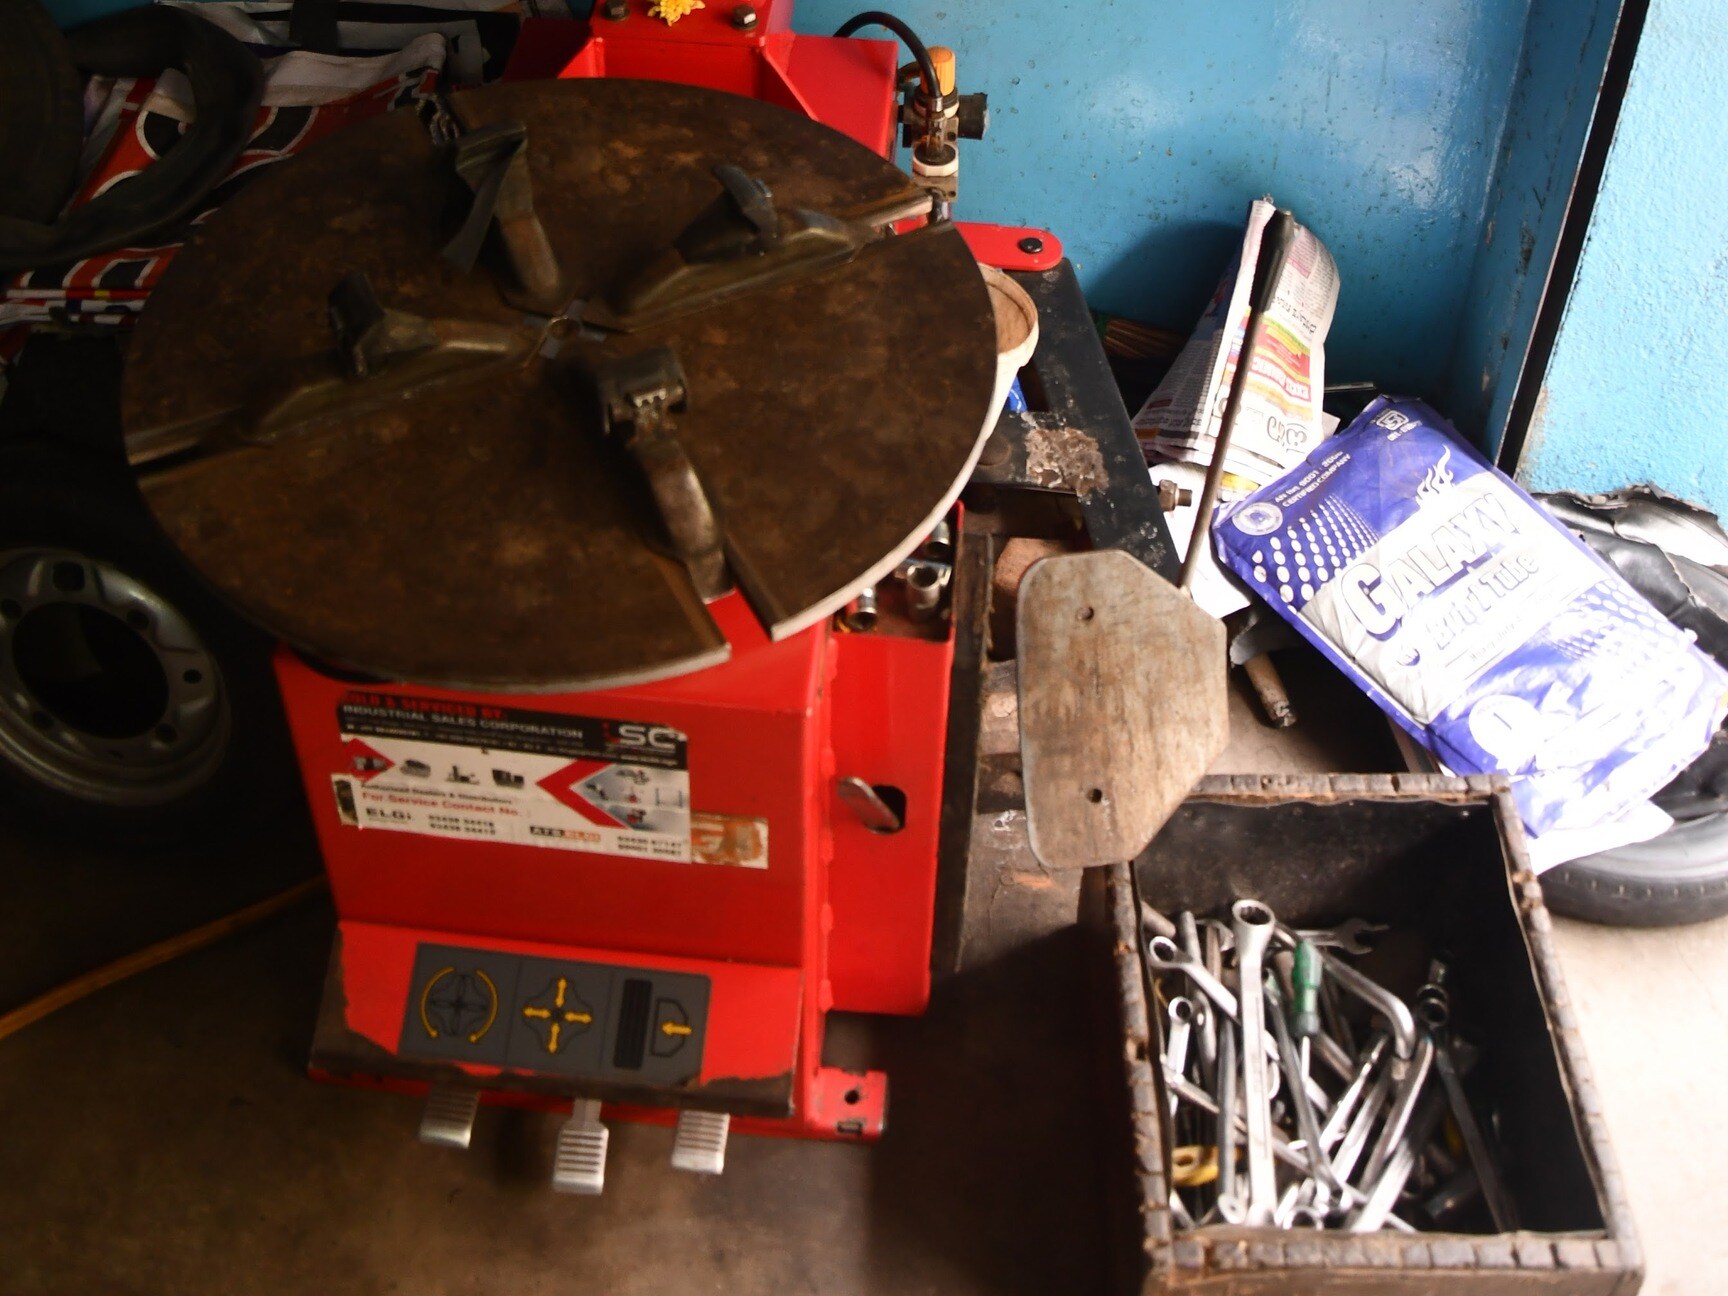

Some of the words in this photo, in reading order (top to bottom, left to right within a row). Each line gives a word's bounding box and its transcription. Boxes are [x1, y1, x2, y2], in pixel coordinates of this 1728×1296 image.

[1282, 481, 1320, 508] CERTIFIED
[1316, 452, 1352, 484] COMPANY
[1340, 491, 1521, 642] GALAXY
[1478, 549, 1541, 599] Tube
[343, 704, 426, 721] INDUSTRIAL
[431, 713, 477, 728] SALES
[480, 718, 584, 740] CORPORATION
[361, 791, 384, 803] For
[387, 793, 438, 807] Service
[442, 800, 496, 813] Contact
